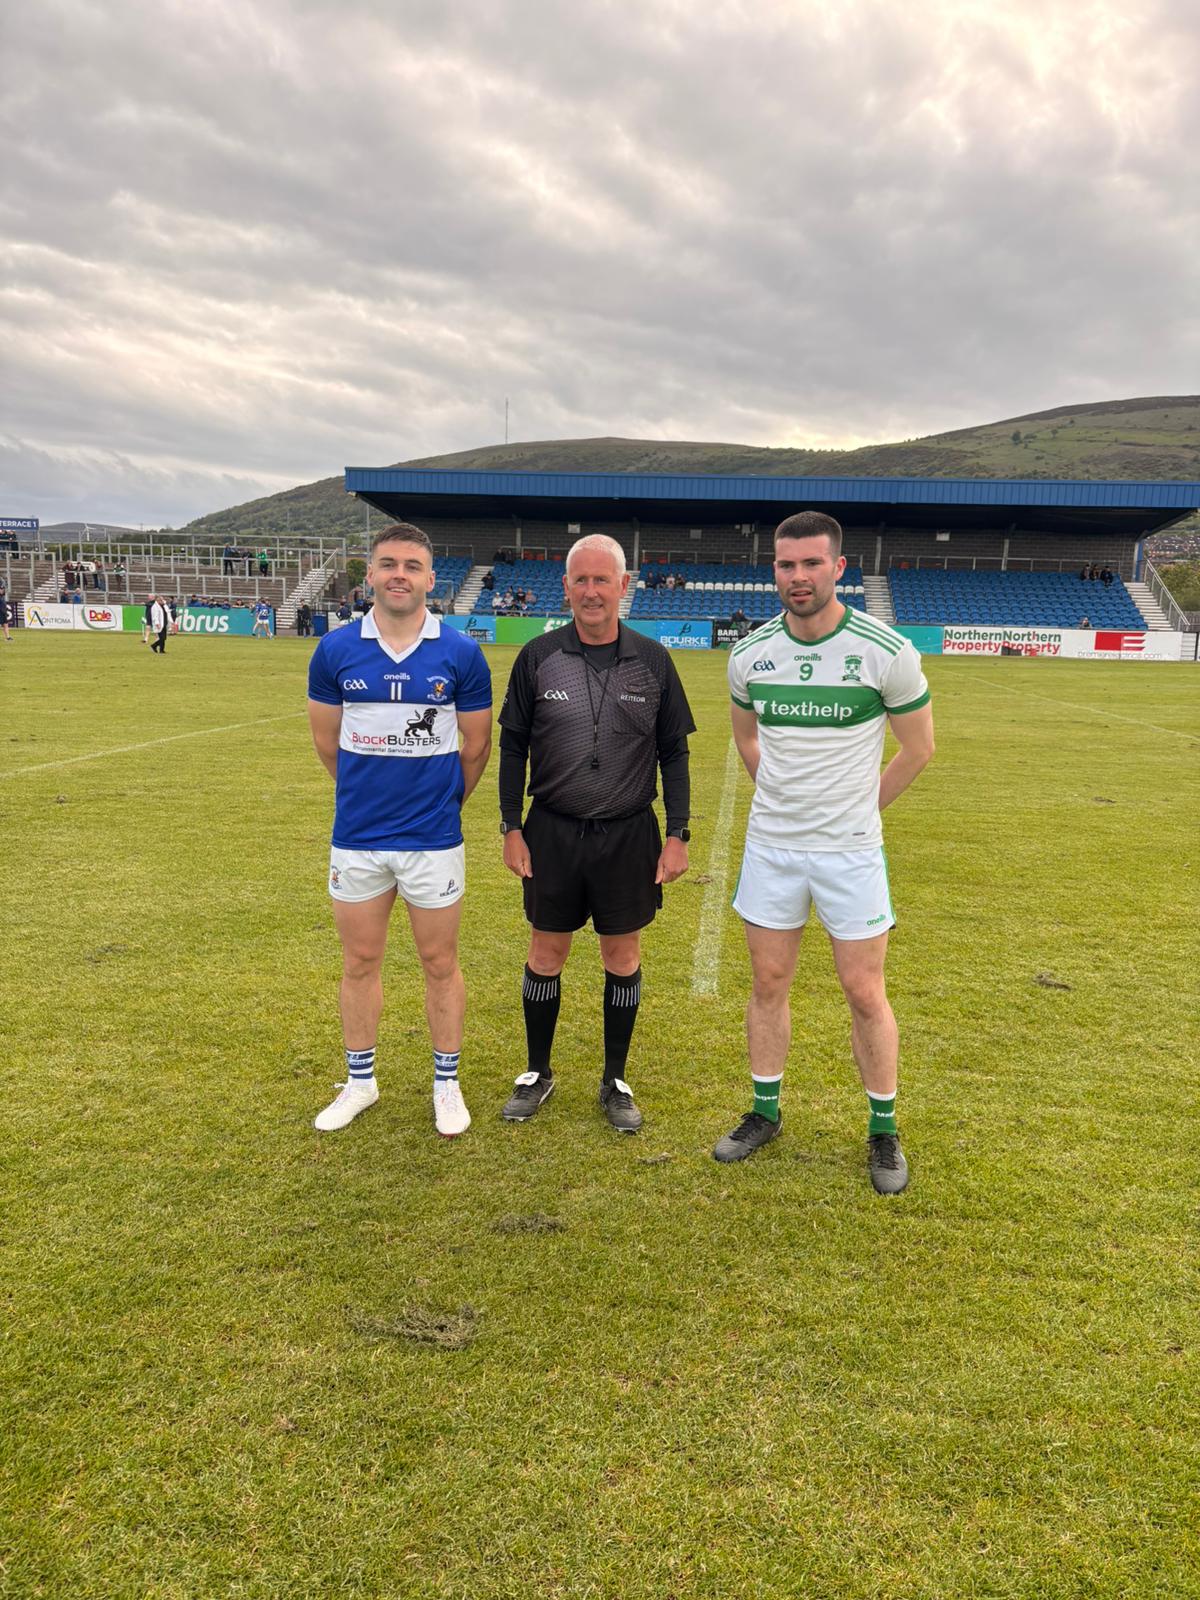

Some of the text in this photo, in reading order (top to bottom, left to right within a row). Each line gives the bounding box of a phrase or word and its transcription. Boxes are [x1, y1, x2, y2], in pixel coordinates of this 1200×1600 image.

[89, 610, 112, 621] Dole
[176, 609, 229, 633] ibrus
[660, 635, 709, 645] BOURKE
[944, 629, 1002, 641] Northern
[943, 639, 1001, 653] Property
[794, 653, 822, 661] oneills
[753, 659, 776, 671] GAA
[384, 672, 411, 680] oneills
[799, 663, 813, 681] 9
[343, 679, 368, 691] GAA
[391, 682, 402, 700] 11
[544, 689, 570, 701] GAA
[771, 700, 852, 721] texthelp
